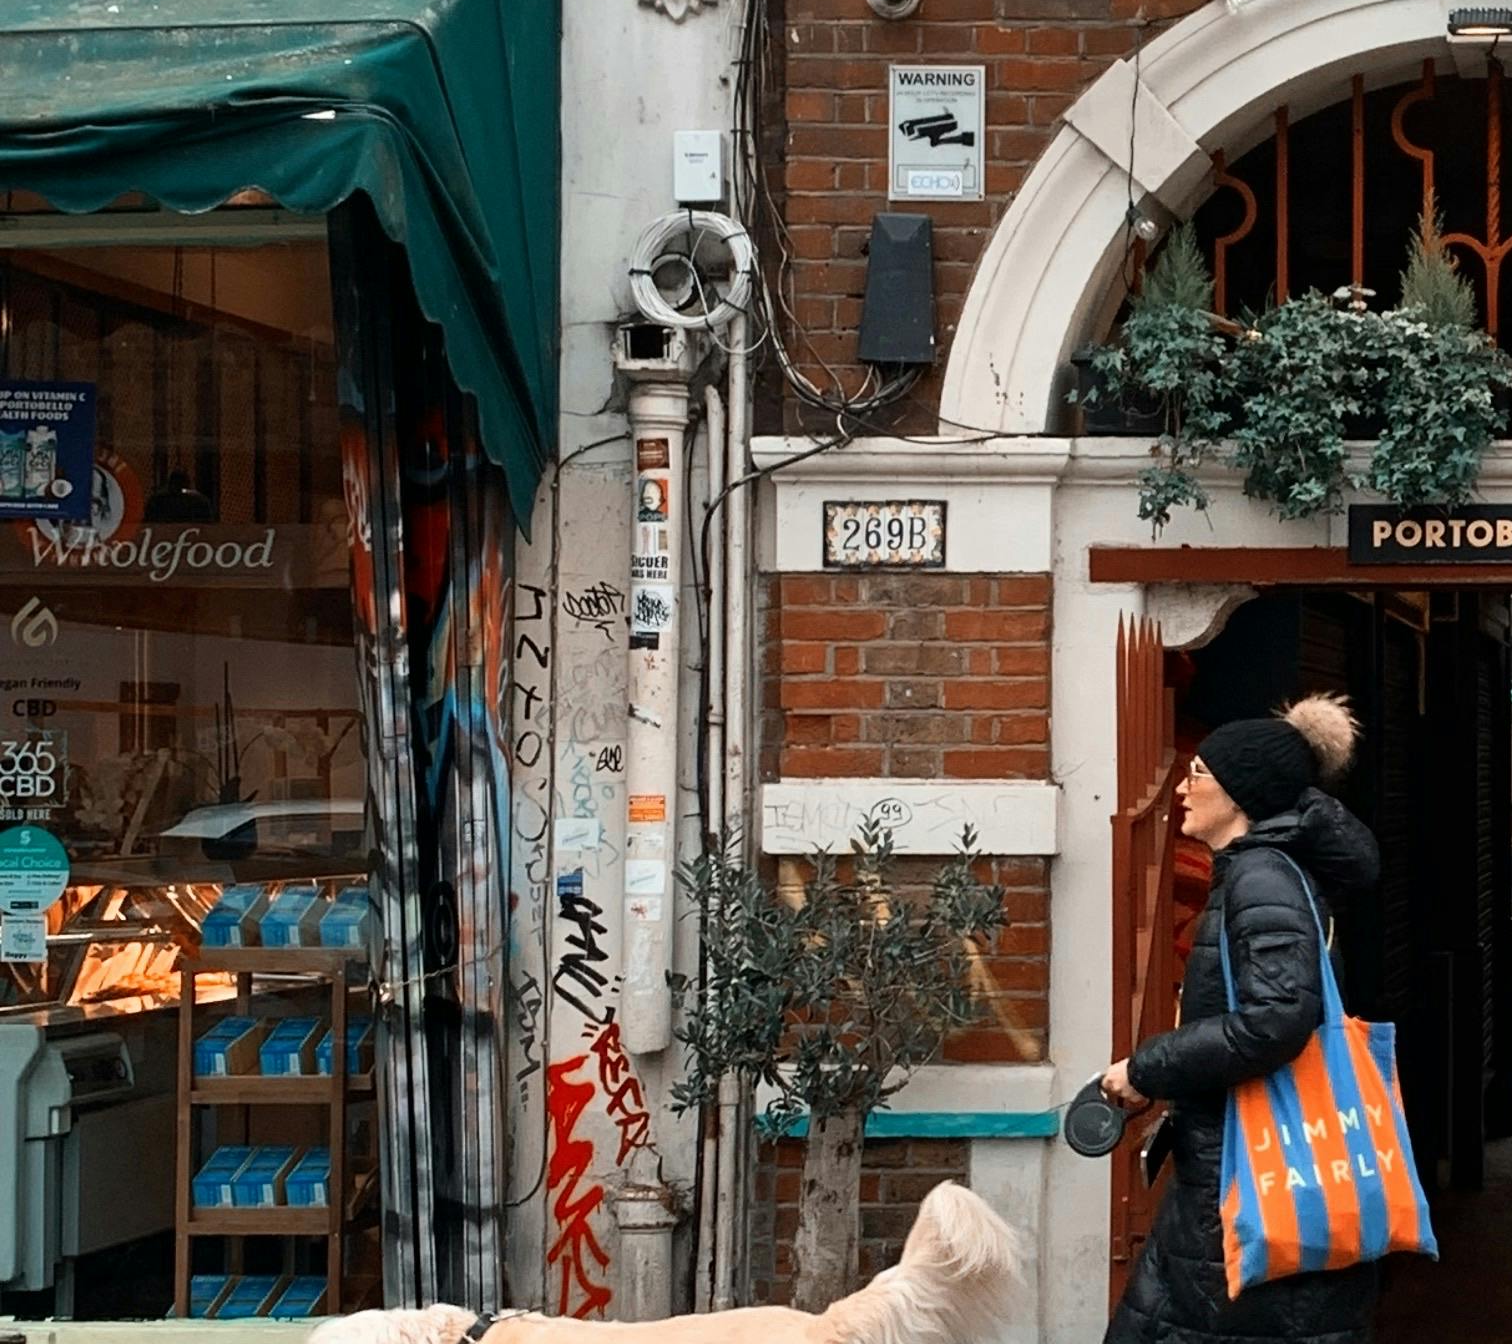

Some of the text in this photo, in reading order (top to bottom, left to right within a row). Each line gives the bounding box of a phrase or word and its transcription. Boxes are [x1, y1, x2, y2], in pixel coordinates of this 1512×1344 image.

[898, 72, 976, 87] WARNING
[31, 391, 77, 401] VITAMIN
[31, 411, 69, 421] FOODS
[843, 517, 926, 551] 269B
[28, 527, 276, 582] Wholefood
[31, 677, 81, 692] Friendly
[12, 698, 57, 718] CBD
[0, 741, 57, 776] 365
[0, 775, 56, 798] CBD
[1254, 1104, 1384, 1153] JIMMY
[1259, 1149, 1396, 1197] FAIRLY
